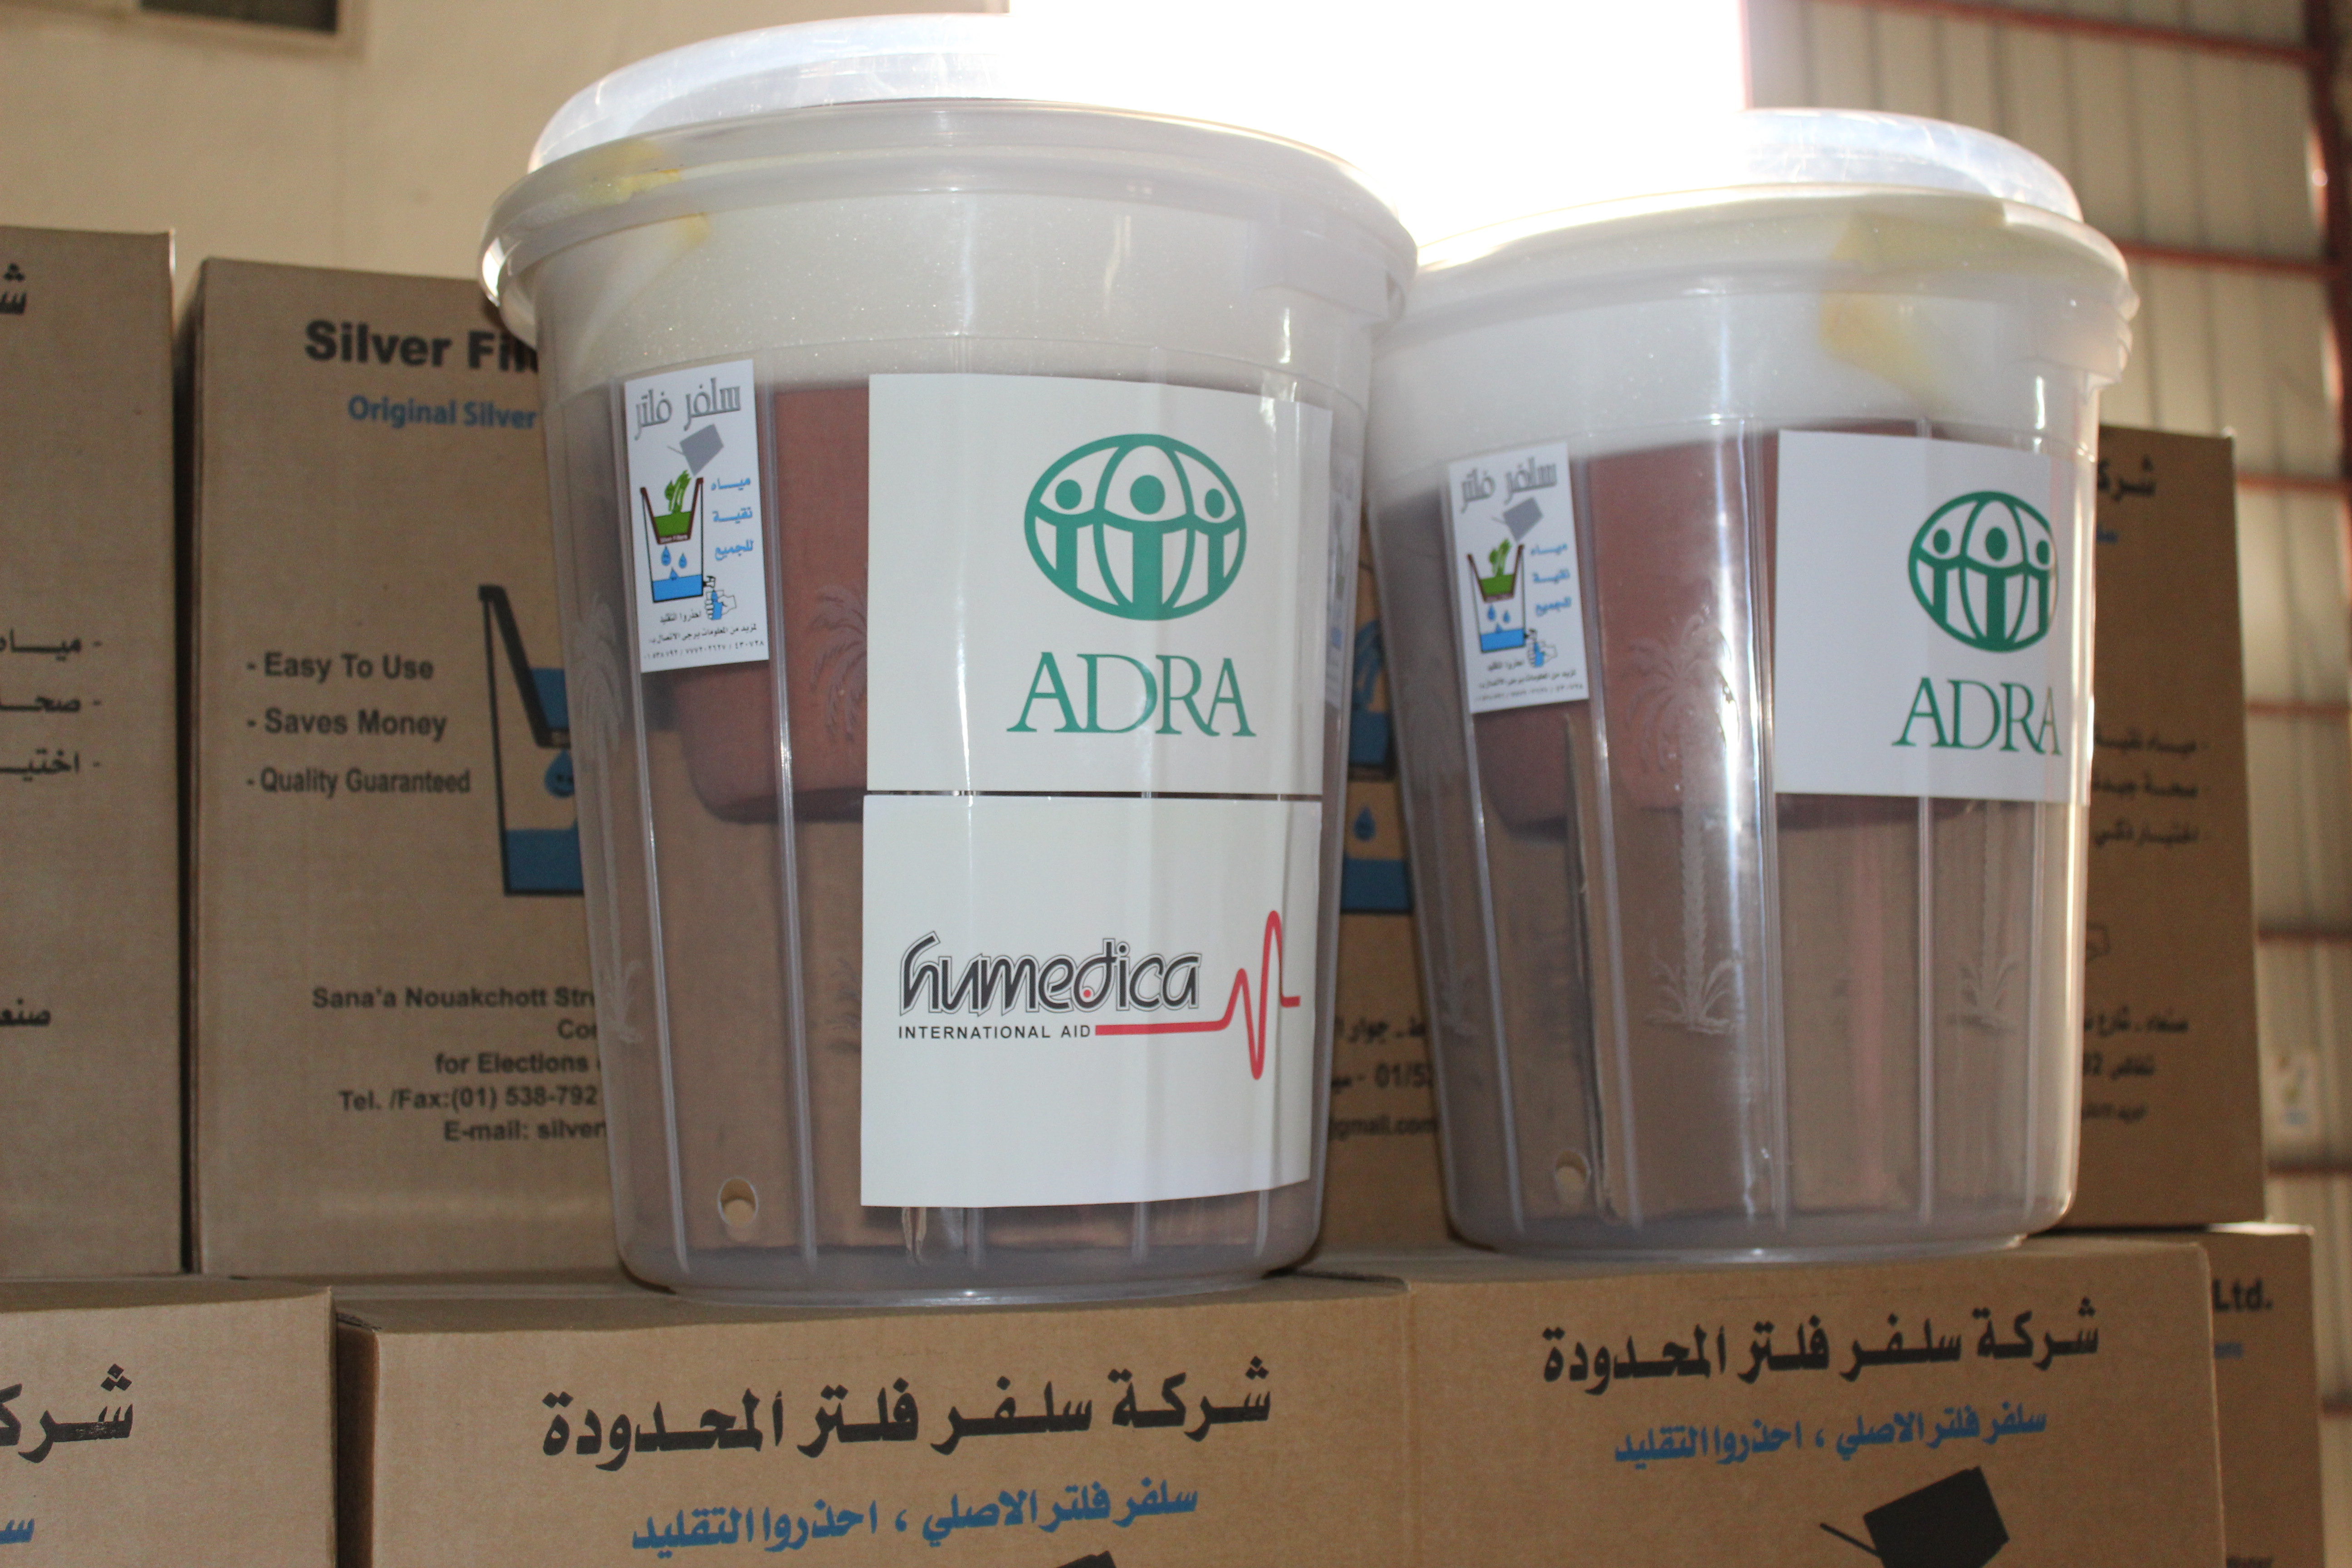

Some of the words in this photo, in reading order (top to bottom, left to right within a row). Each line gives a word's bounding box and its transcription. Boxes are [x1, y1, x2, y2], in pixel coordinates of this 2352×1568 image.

[305, 319, 452, 368] Silver
[348, 395, 456, 429] Original
[463, 402, 537, 430] Silver
[635, 388, 672, 441] فلتر
[684, 377, 741, 431] سلفر
[710, 478, 751, 491] مياه
[712, 507, 753, 524] نقية
[715, 539, 754, 561] للجميع
[263, 652, 332, 682] Easy
[340, 652, 374, 679] To
[382, 655, 434, 680] Use
[0, 695, 80, 713] صح
[1006, 652, 1257, 738] ADRA
[1891, 677, 2063, 756] ADRA
[264, 707, 348, 735] Saves
[357, 709, 447, 743] Money
[0, 749, 79, 783] اختي
[260, 767, 338, 799] Quality
[345, 768, 471, 794] Guaranteed
[313, 987, 397, 1009] Sana'a
[405, 987, 547, 1008] Nouakchott
[900, 931, 1202, 1017] humedica
[0, 997, 51, 1027] صنع
[899, 1025, 1050, 1039] INTERNATIONAL
[1060, 1024, 1090, 1038] AID
[436, 1054, 470, 1074] for
[477, 1053, 589, 1074] Elections
[339, 1090, 381, 1112] Tel.
[505, 1085, 598, 1107] 538-792
[443, 1120, 530, 1142] E-mail:
[537, 1119, 607, 1141] silver
[2212, 1278, 2274, 1313] Ltd.
[1737, 1314, 1830, 1385] فلتر
[1839, 1313, 1963, 1382] سلفر
[1971, 1296, 2099, 1372] شركة
[1542, 1323, 1727, 1396] المحدودة
[0, 1363, 133, 1464] شرك
[797, 1377, 919, 1458] فلتر
[930, 1375, 1093, 1455] سلفر
[1108, 1356, 1271, 1442] شركة
[1982, 1401, 2048, 1446] سلفر
[542, 1388, 784, 1472] المحدودة
[1615, 1425, 1709, 1470] التقليد
[1716, 1418, 1802, 1465] احذروا
[1836, 1411, 1925, 1462] الاصلي
[1926, 1404, 1980, 1450] فلتر
[764, 1498, 879, 1553] احذروا
[921, 1488, 1038, 1548] الاصلي
[1039, 1480, 1111, 1533] فلتر
[1112, 1476, 1198, 1528] سلفر
[632, 1505, 755, 1559] التقليد
